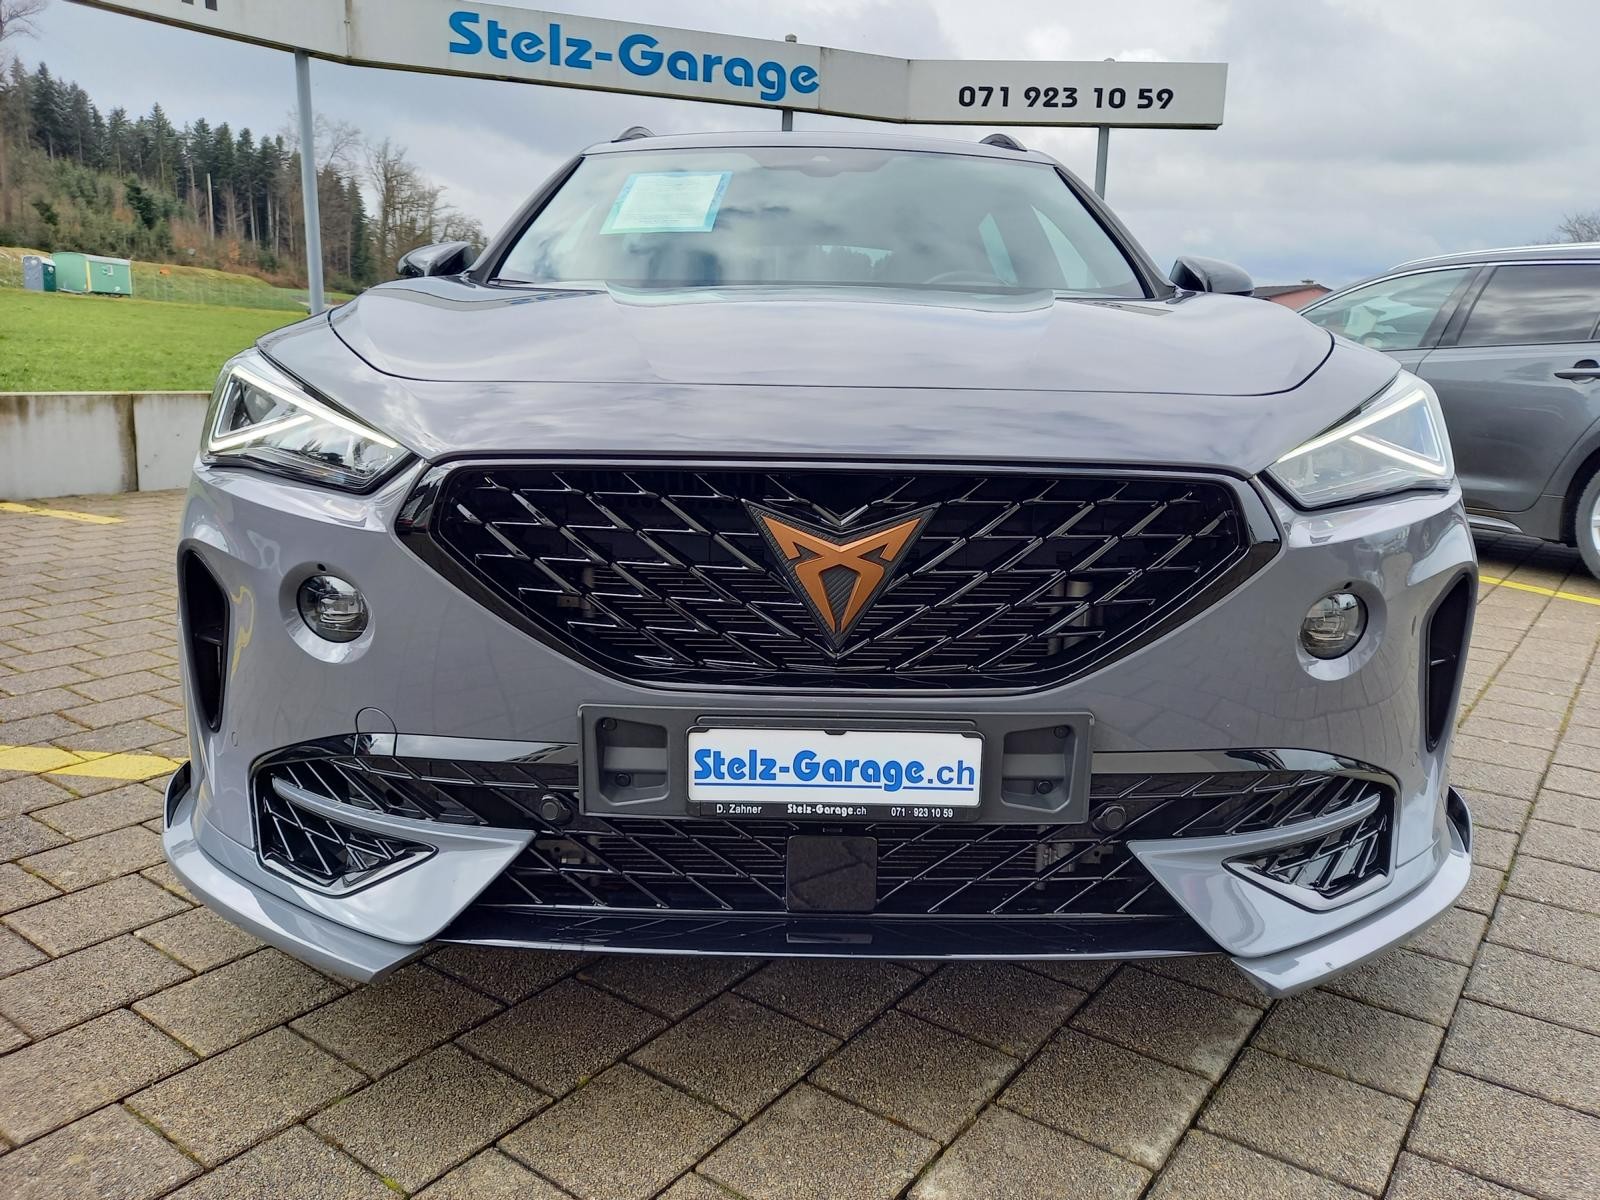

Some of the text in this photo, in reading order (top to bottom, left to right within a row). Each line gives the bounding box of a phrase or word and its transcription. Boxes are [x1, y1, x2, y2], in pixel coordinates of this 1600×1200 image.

[448, 10, 819, 102] Stelz-Garage
[958, 85, 1174, 110] 071 923 10 59
[694, 748, 976, 793] Stelz-Garage.ch
[716, 803, 763, 814] D. Zahner
[787, 803, 867, 817] Stelz-Garage.ch
[890, 806, 906, 817] 071
[913, 807, 929, 817] 923
[931, 807, 941, 818] 10
[942, 807, 954, 818] 59
